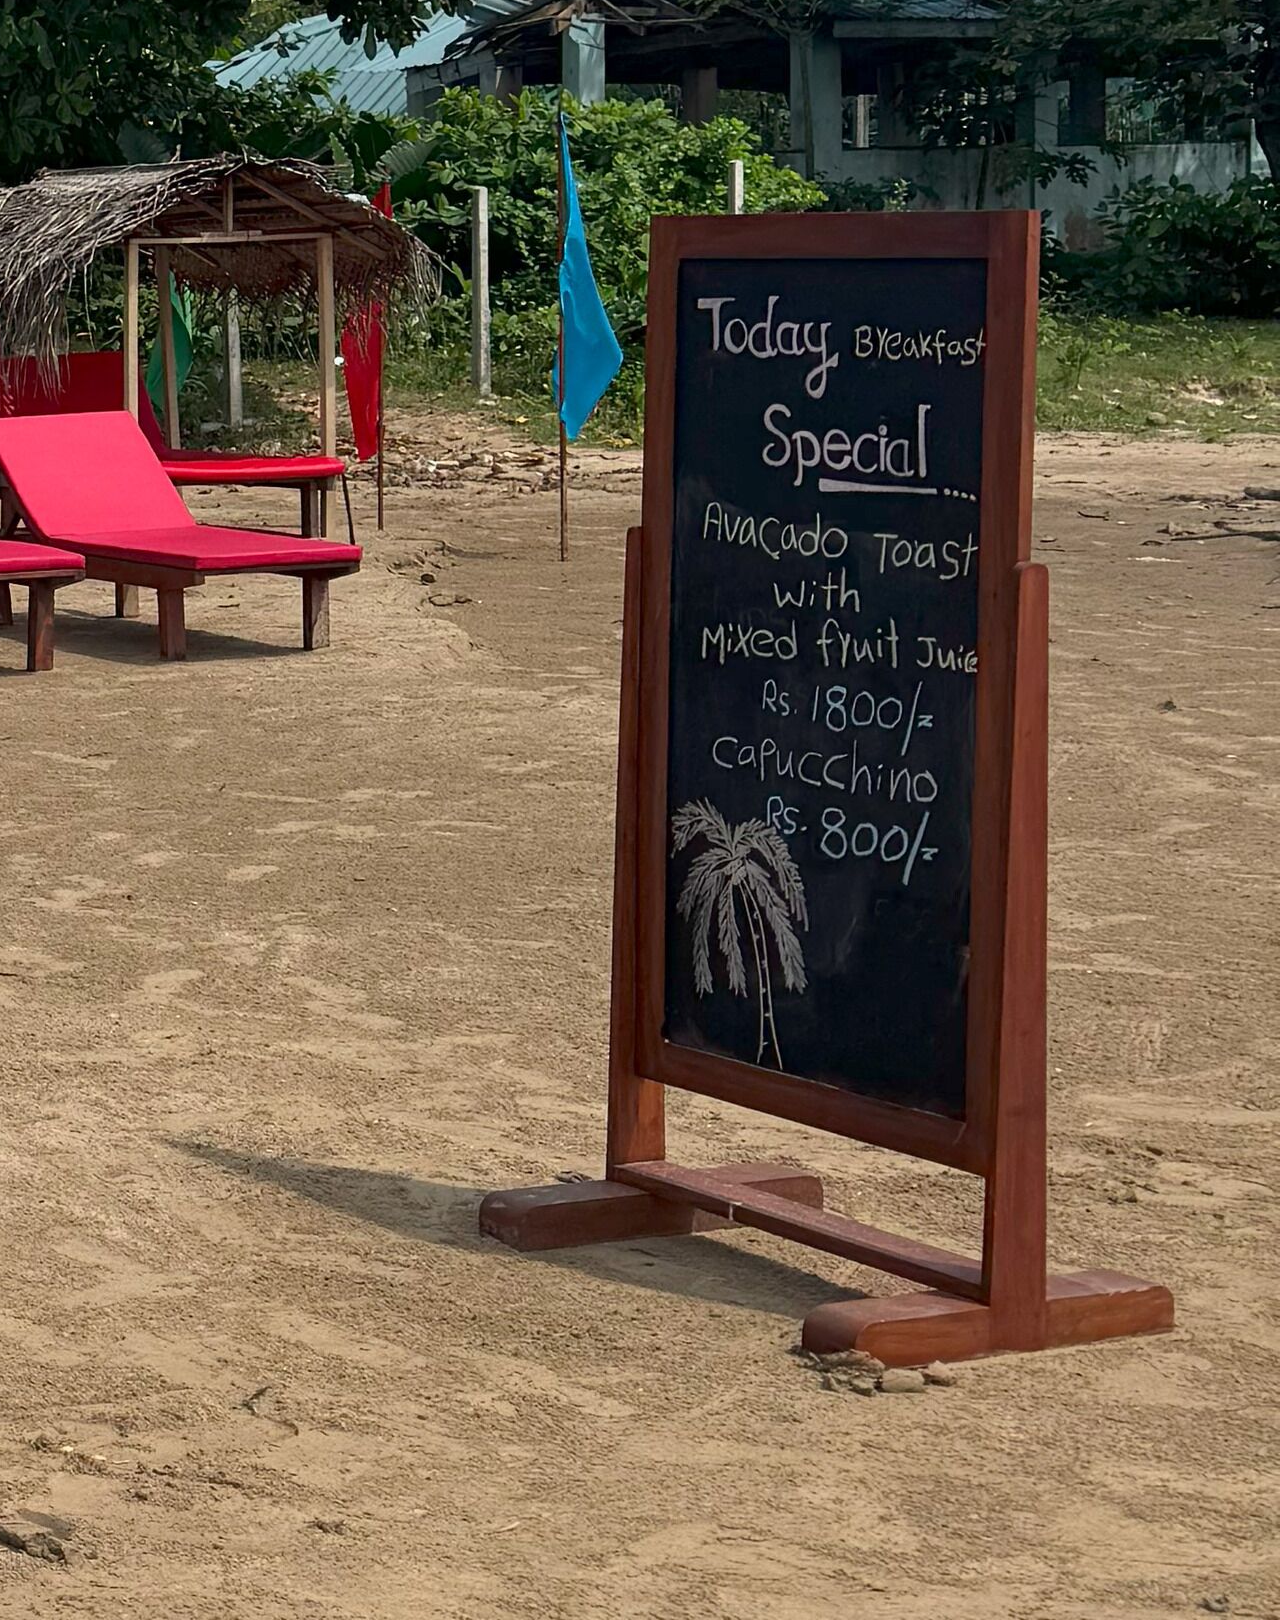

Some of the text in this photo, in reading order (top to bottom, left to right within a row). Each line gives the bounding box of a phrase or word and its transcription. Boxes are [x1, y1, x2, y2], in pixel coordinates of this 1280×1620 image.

[697, 294, 840, 399] Today
[761, 403, 932, 487] Special
[873, 531, 980, 581] Toast
[701, 619, 798, 666] Mixed
[915, 636, 978, 673] Juice
